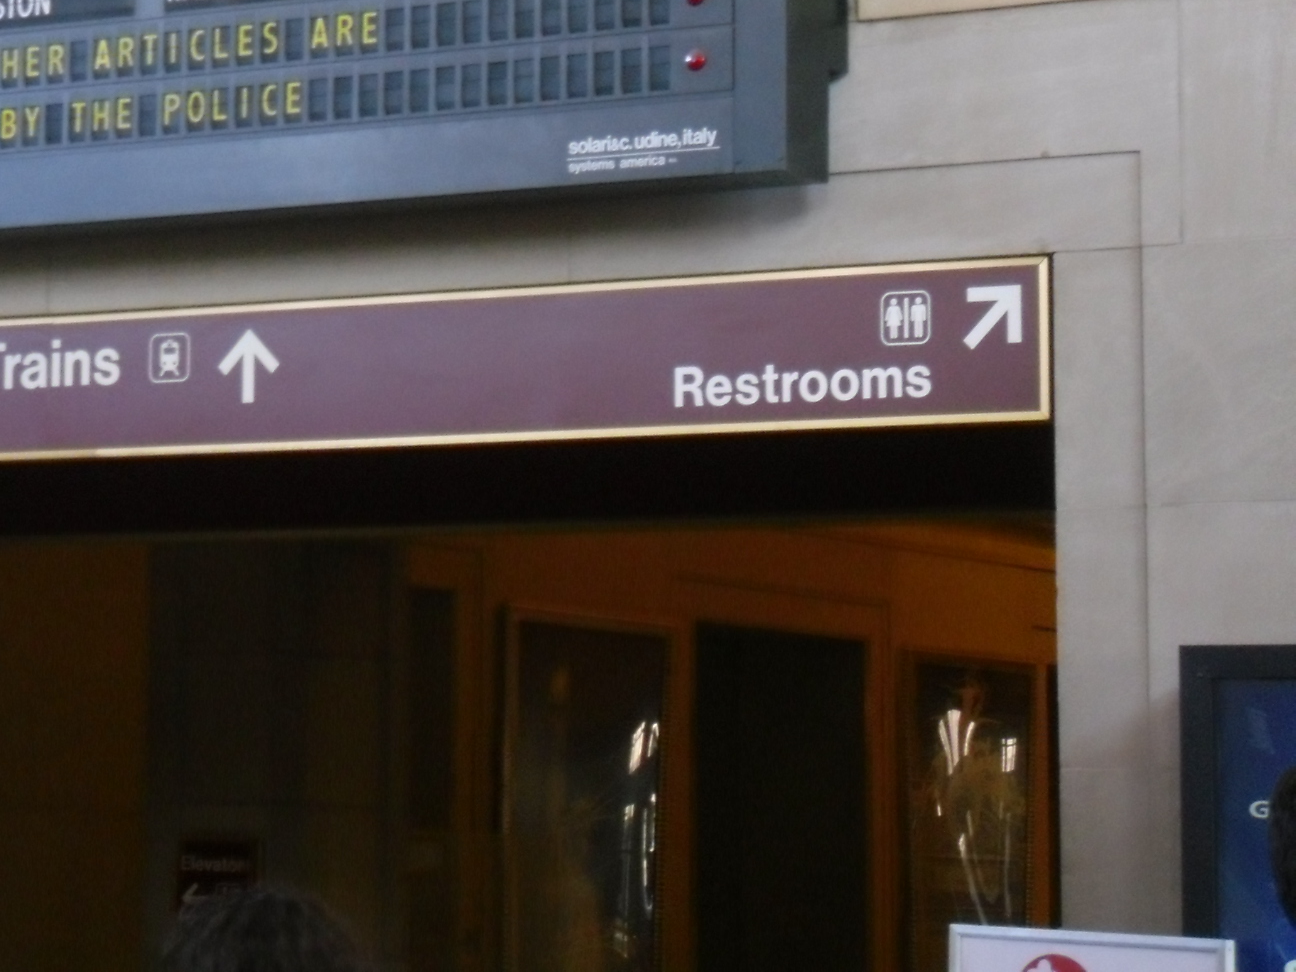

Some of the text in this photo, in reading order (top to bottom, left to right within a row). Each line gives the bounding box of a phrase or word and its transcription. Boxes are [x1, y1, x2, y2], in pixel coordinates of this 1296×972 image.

[94, 22, 278, 70] ARTICLES
[311, 11, 378, 49] ARE
[0, 105, 40, 140] BY
[72, 97, 132, 133] THE
[163, 81, 301, 125] POLICE
[619, 155, 666, 169] america
[673, 361, 933, 409] Restrooms
